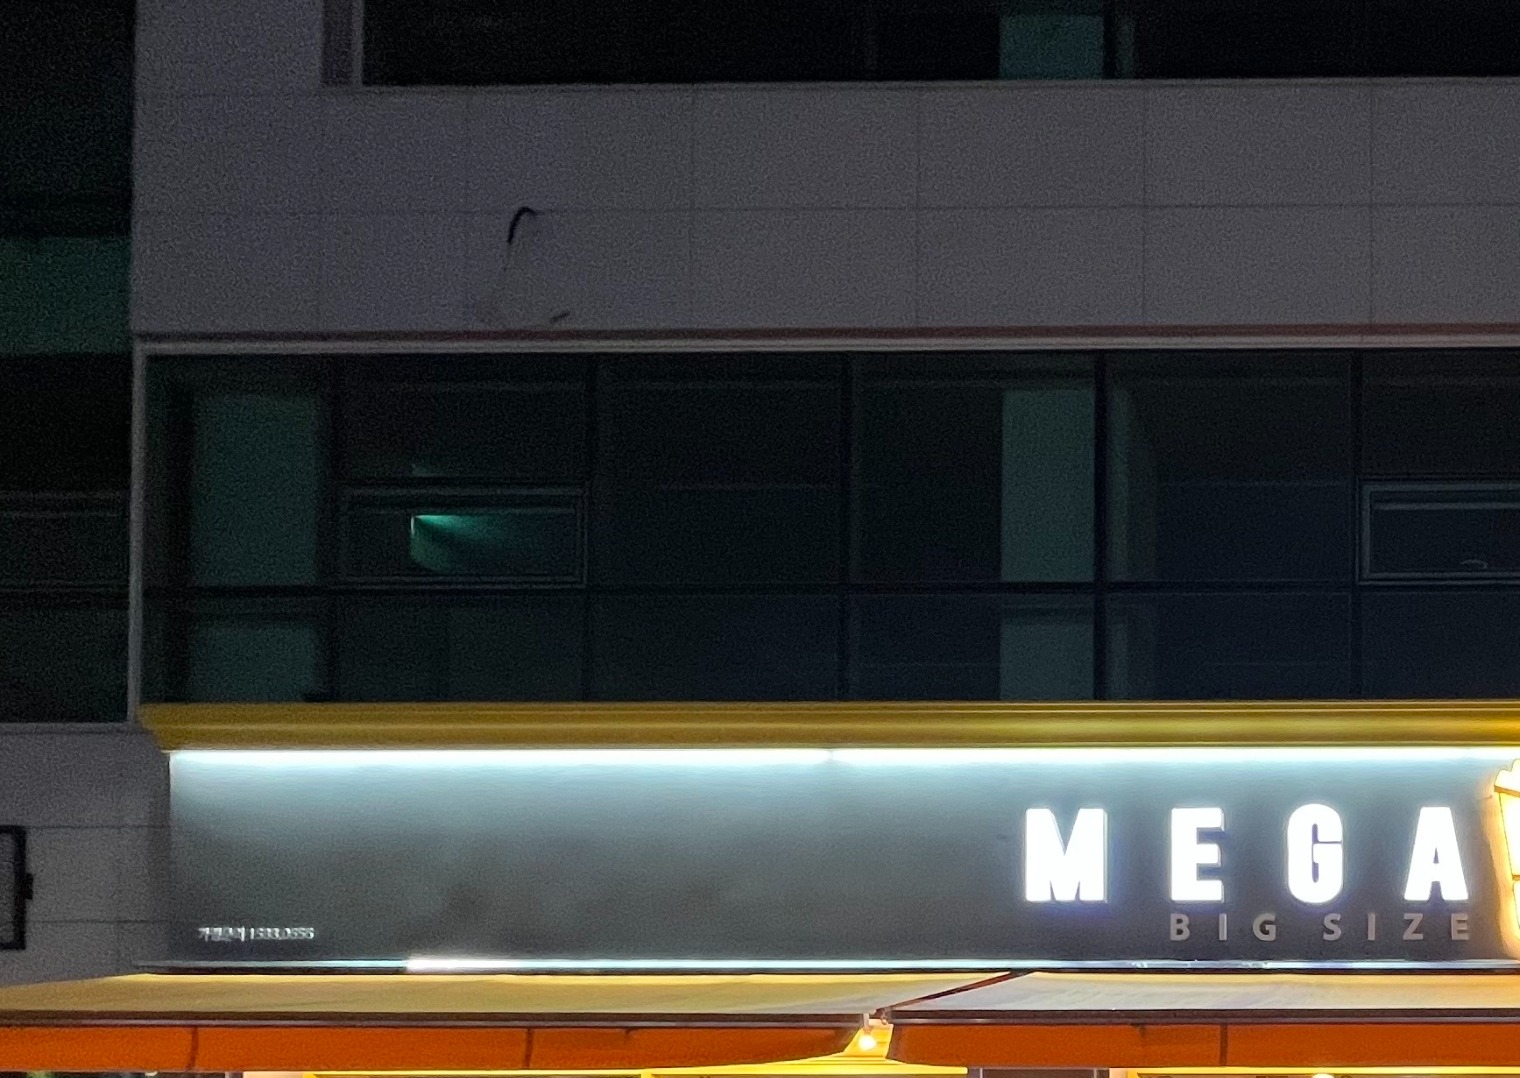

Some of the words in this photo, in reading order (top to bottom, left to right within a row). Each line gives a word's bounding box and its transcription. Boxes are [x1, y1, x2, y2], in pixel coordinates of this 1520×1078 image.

[1024, 802, 1470, 904] MEGA
[1169, 912, 1277, 942] BIG
[1322, 912, 1470, 942] SIZE
